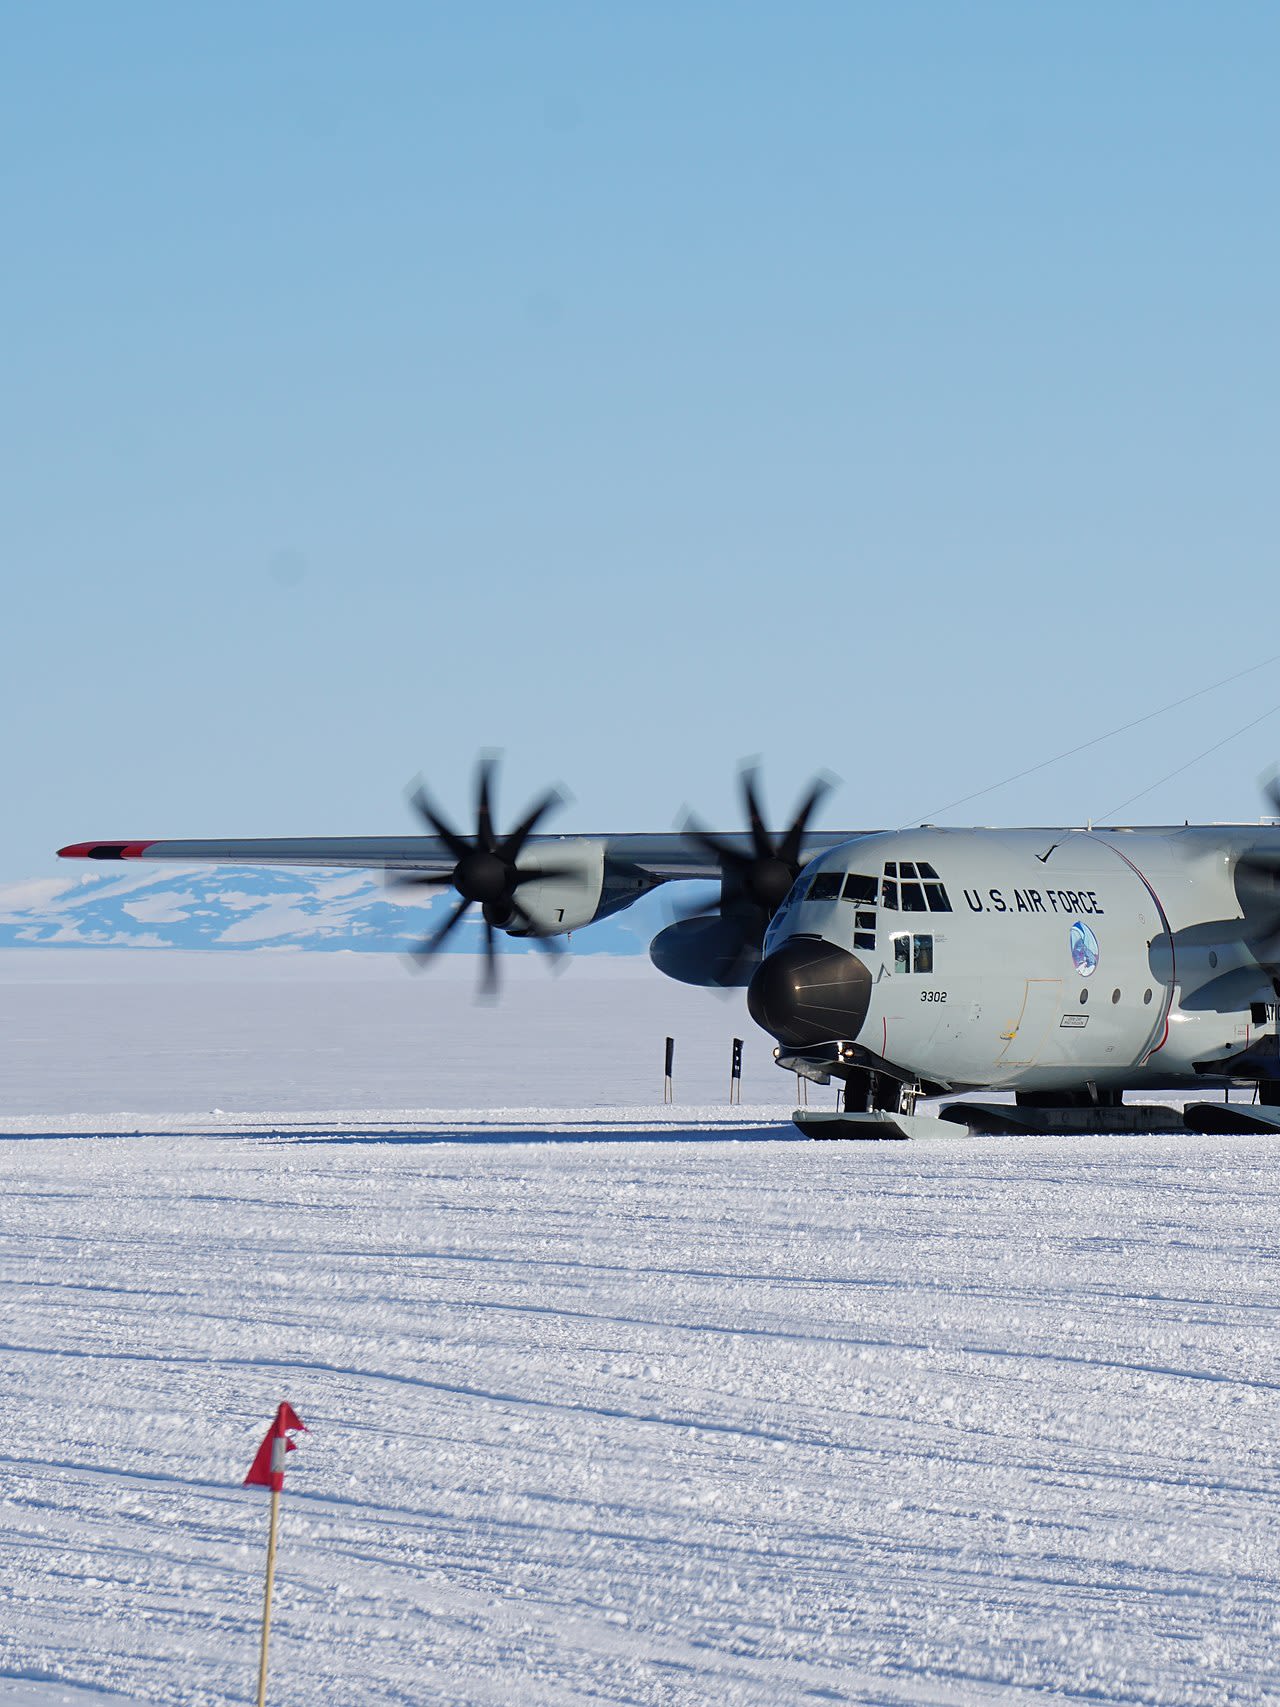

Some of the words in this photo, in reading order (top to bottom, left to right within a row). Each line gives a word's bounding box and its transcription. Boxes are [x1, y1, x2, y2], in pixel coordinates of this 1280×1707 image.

[963, 889, 1014, 913] U.S.
[1014, 889, 1047, 913] AIR
[1046, 890, 1105, 914] FORCE
[920, 991, 947, 1003] 3302
